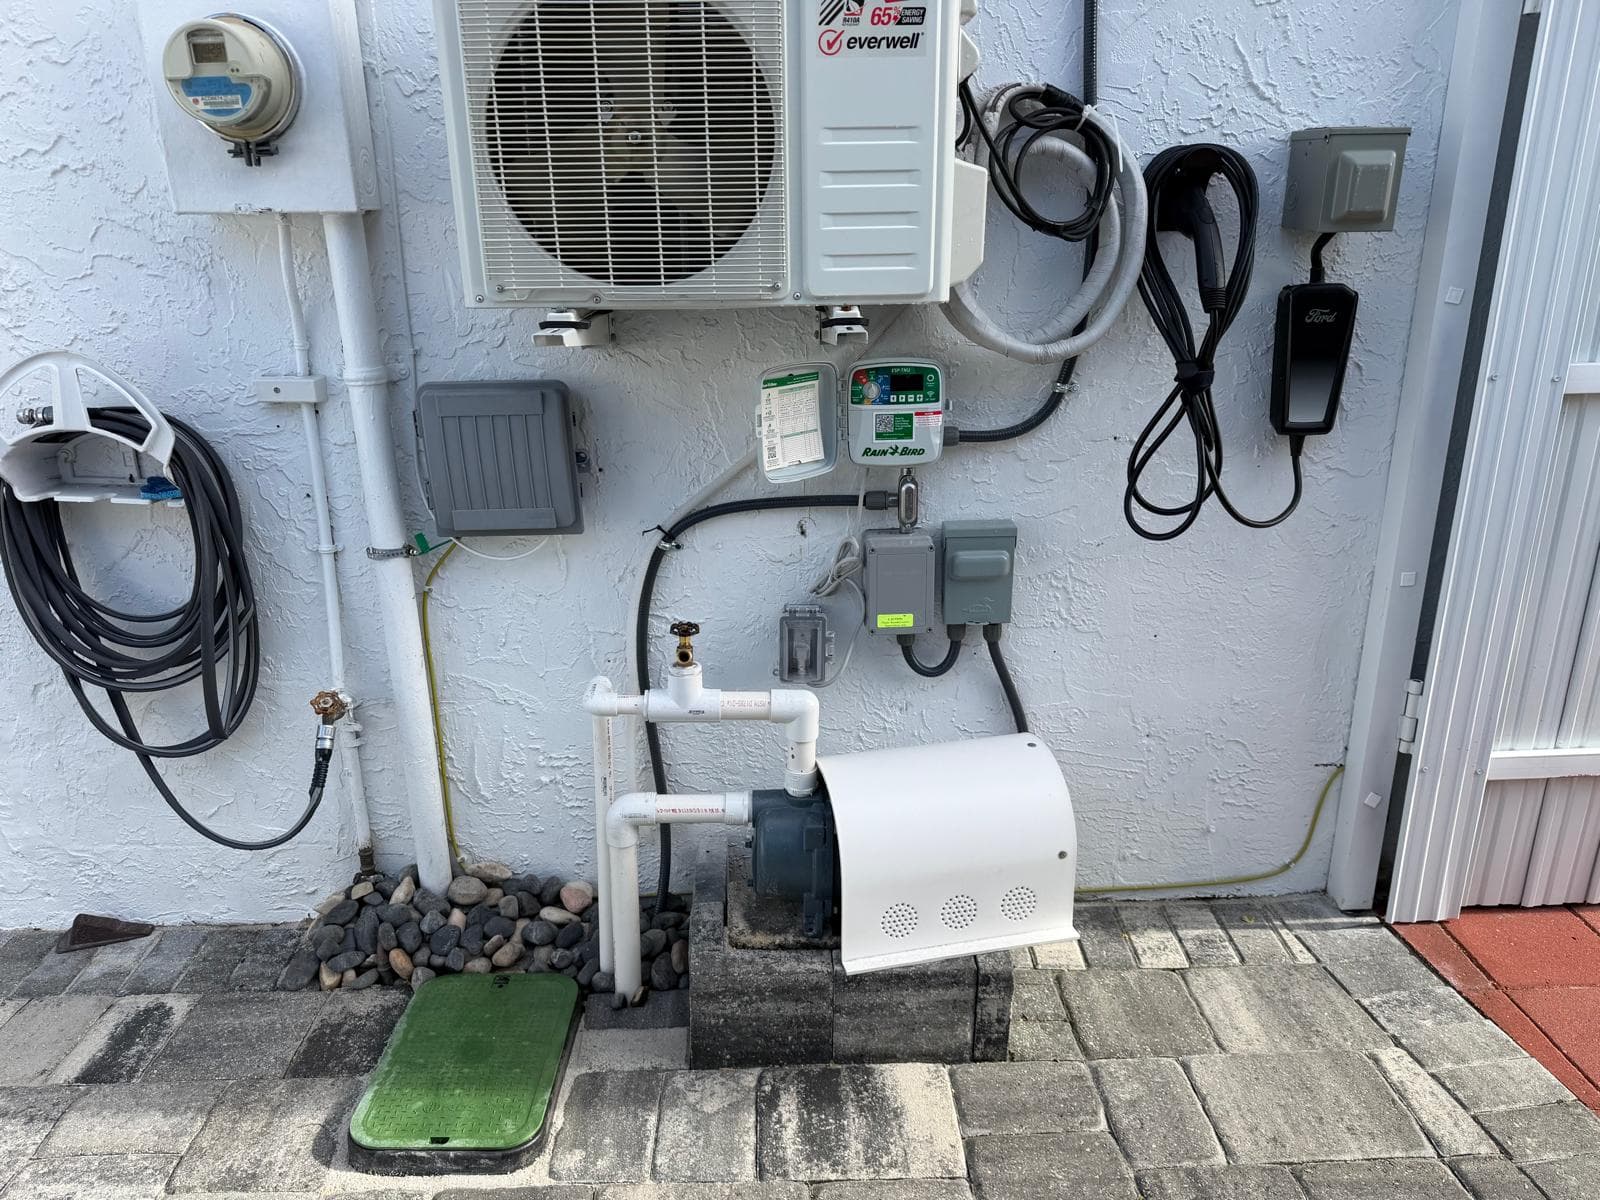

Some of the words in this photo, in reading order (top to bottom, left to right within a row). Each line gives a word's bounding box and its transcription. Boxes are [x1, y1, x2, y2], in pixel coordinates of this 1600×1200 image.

[901, 8, 924, 16] ENERGY
[842, 16, 861, 24] R410A
[901, 16, 923, 24] SAVING
[846, 32, 920, 50] everwell
[1305, 308, 1337, 323] Ford
[862, 447, 889, 457] RAIN
[899, 446, 926, 456] BIRD
